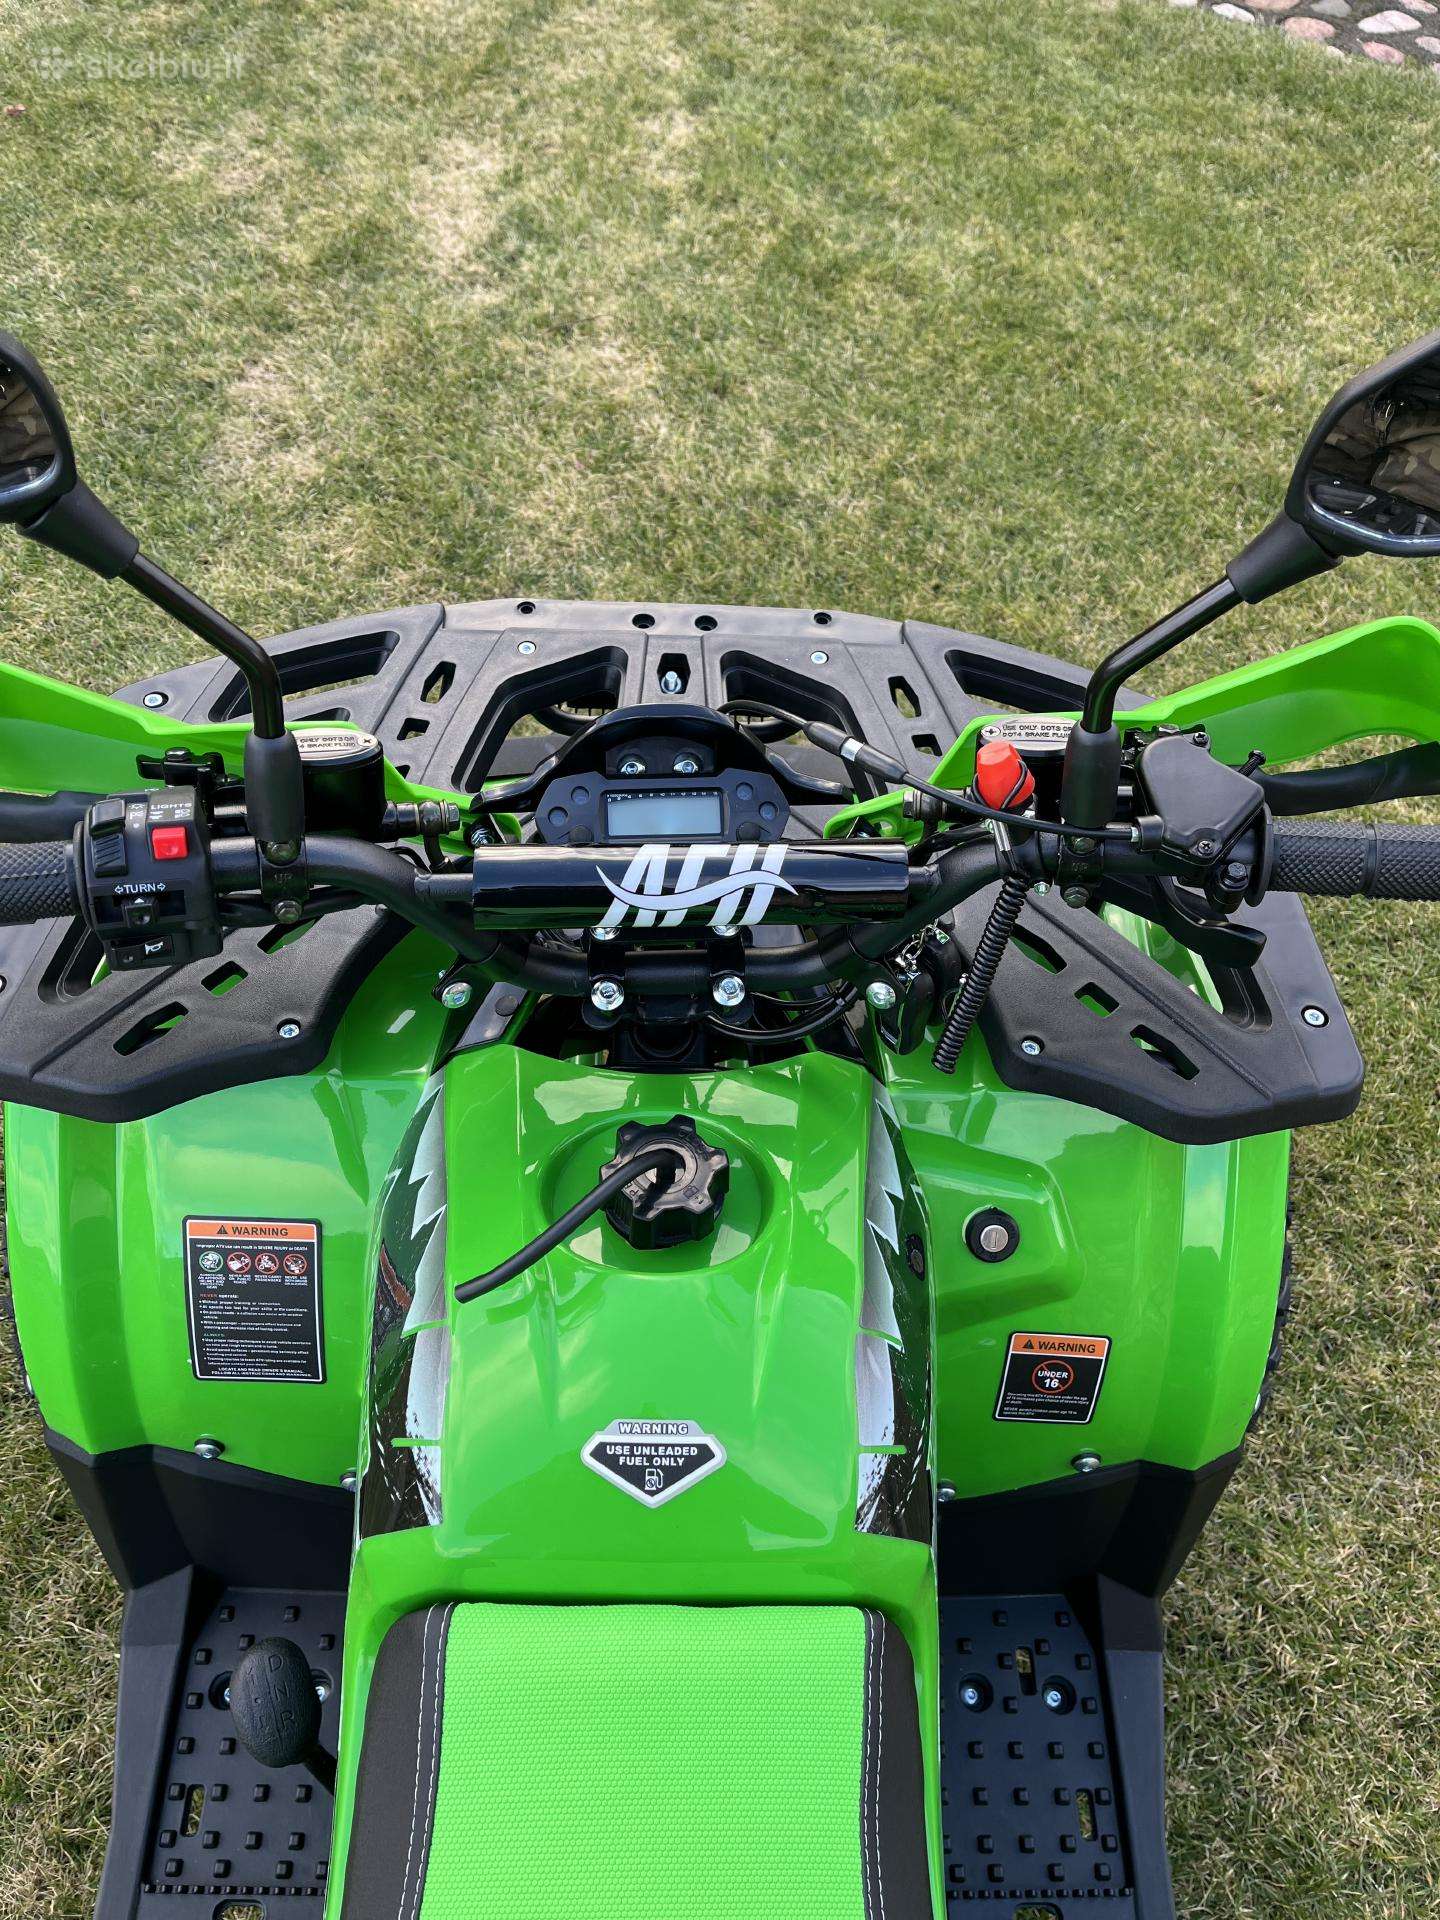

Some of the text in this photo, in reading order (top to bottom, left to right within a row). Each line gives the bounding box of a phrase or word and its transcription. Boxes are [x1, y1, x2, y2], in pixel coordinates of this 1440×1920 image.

[123, 882, 156, 894] TURN
[231, 1226, 289, 1237] WARNING
[1038, 1341, 1096, 1353] WARNING
[1037, 1370, 1069, 1379] UNDER
[1044, 1378, 1060, 1388] 16
[618, 1422, 689, 1435] WARNING
[606, 1445, 698, 1456] USE UNLEADED
[619, 1457, 685, 1466] FUEL ONLY
